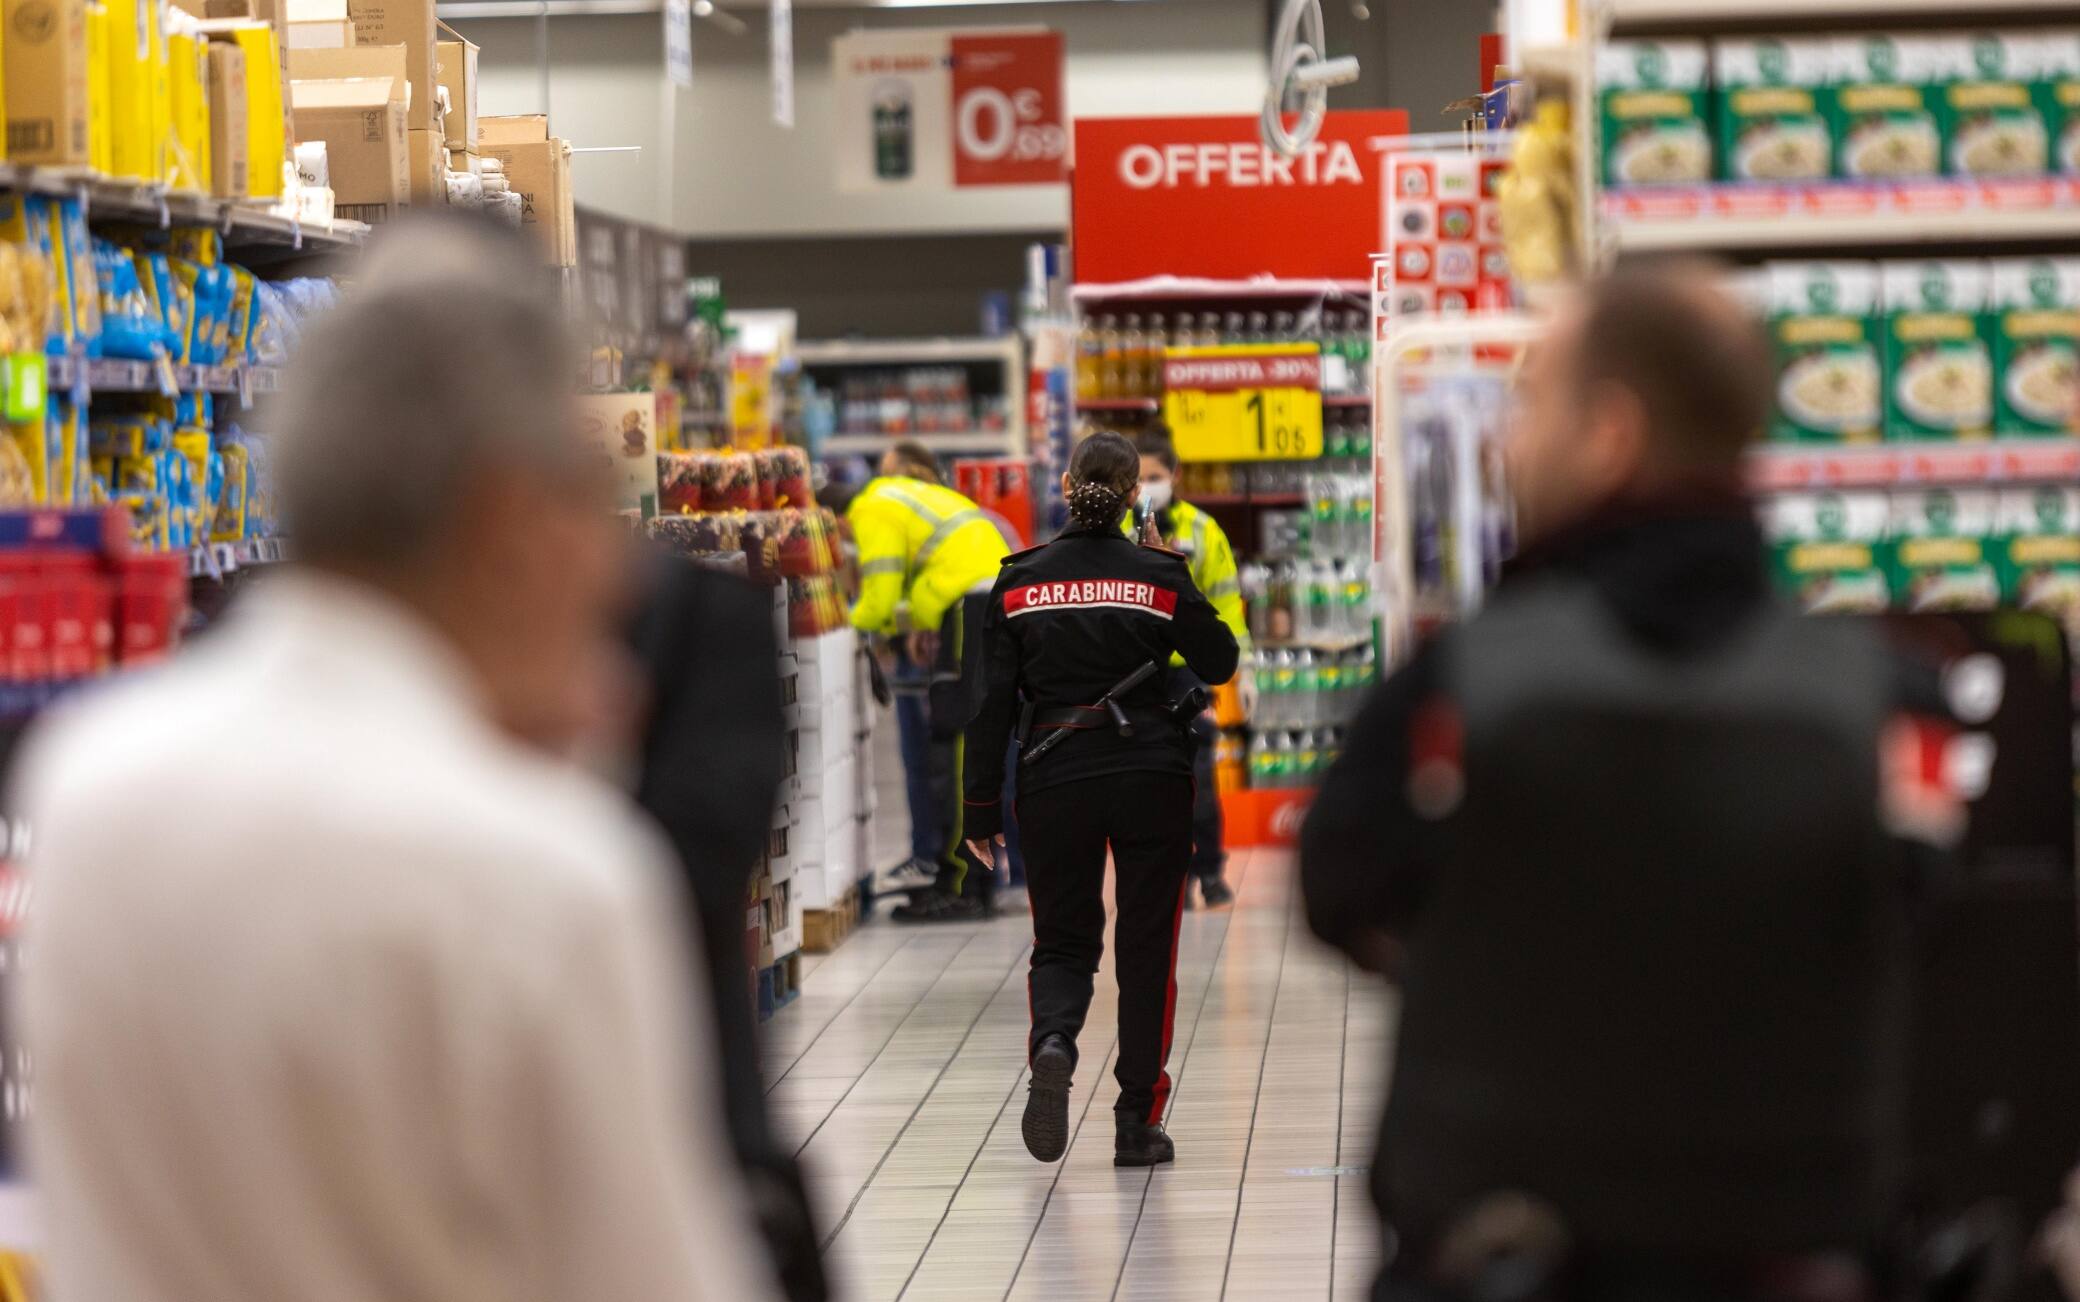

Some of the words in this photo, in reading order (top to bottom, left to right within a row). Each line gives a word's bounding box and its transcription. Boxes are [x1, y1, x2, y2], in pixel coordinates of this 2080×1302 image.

[959, 87, 1014, 160] 0
[1118, 141, 1364, 189] OFFERTA
[1169, 361, 1265, 385] OFFERTA
[1247, 394, 1267, 453] 1
[1025, 581, 1156, 607] CARABINIERI
